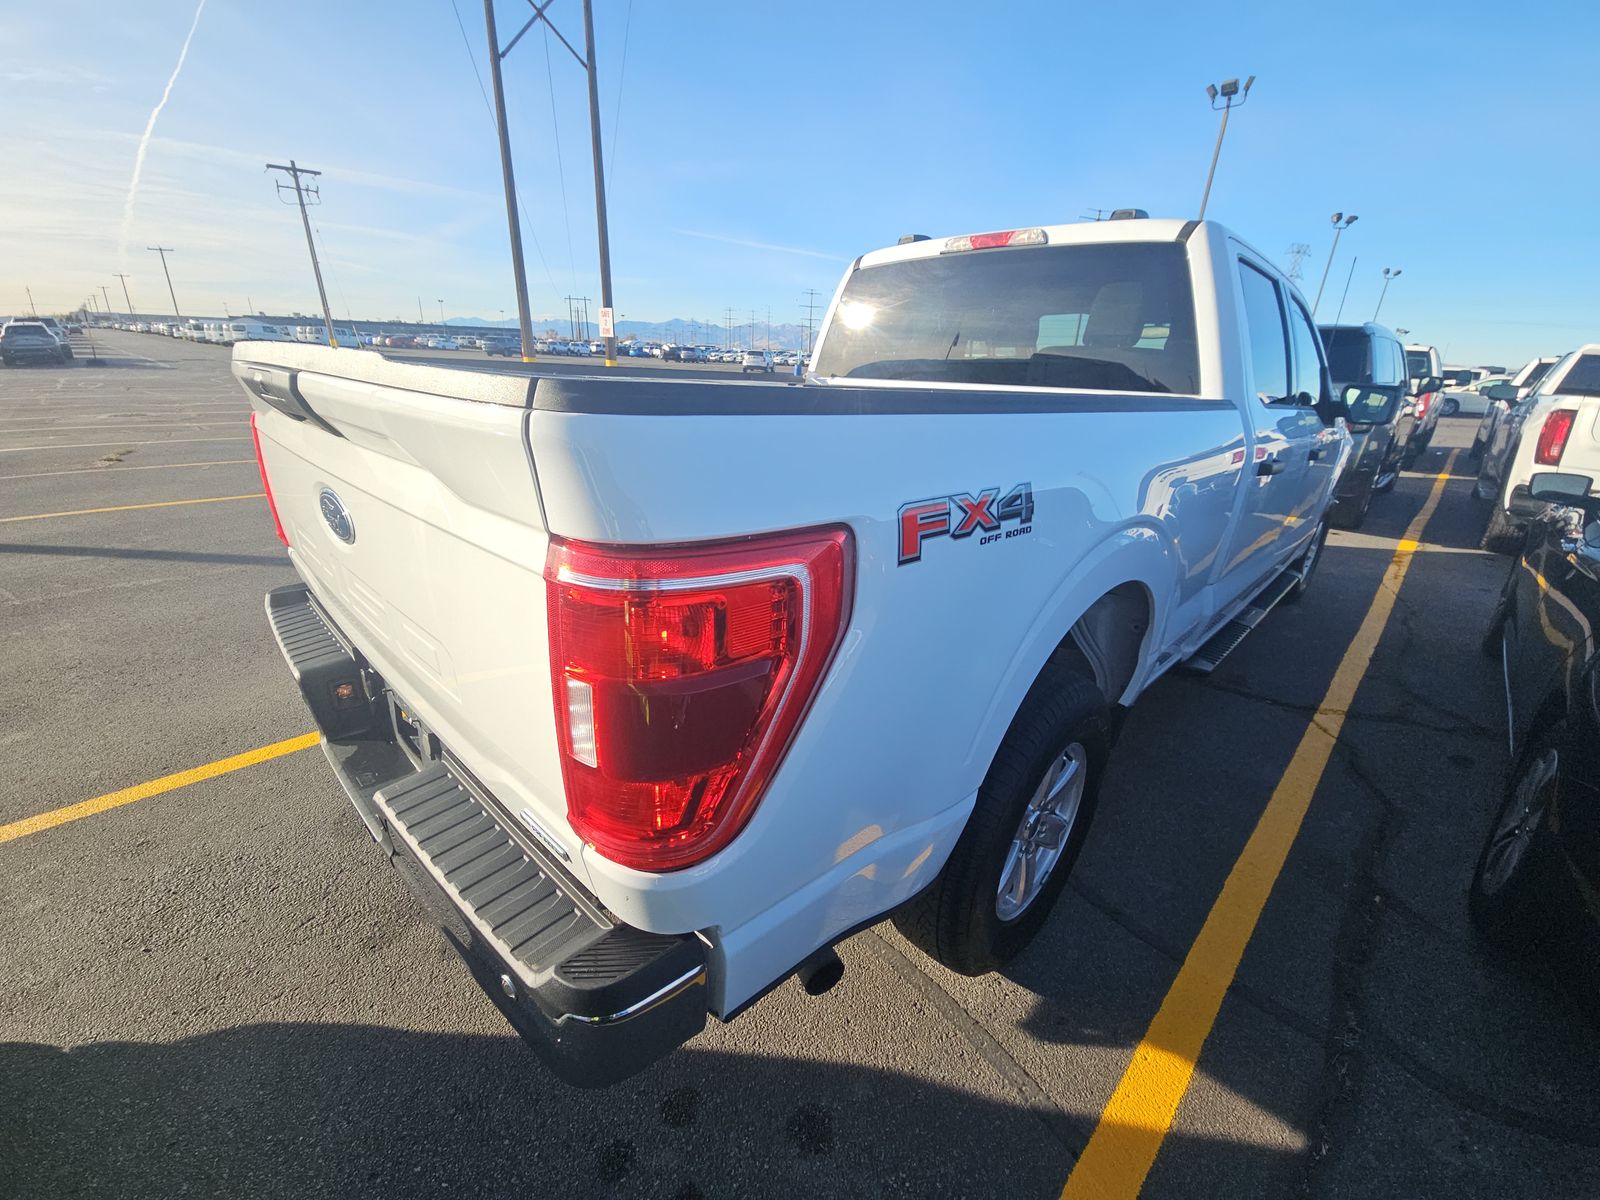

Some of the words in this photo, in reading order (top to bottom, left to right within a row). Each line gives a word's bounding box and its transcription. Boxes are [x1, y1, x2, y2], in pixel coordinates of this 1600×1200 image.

[897, 481, 1034, 568] FX4
[979, 532, 1002, 546] OFF
[1005, 525, 1032, 539] ROAD
